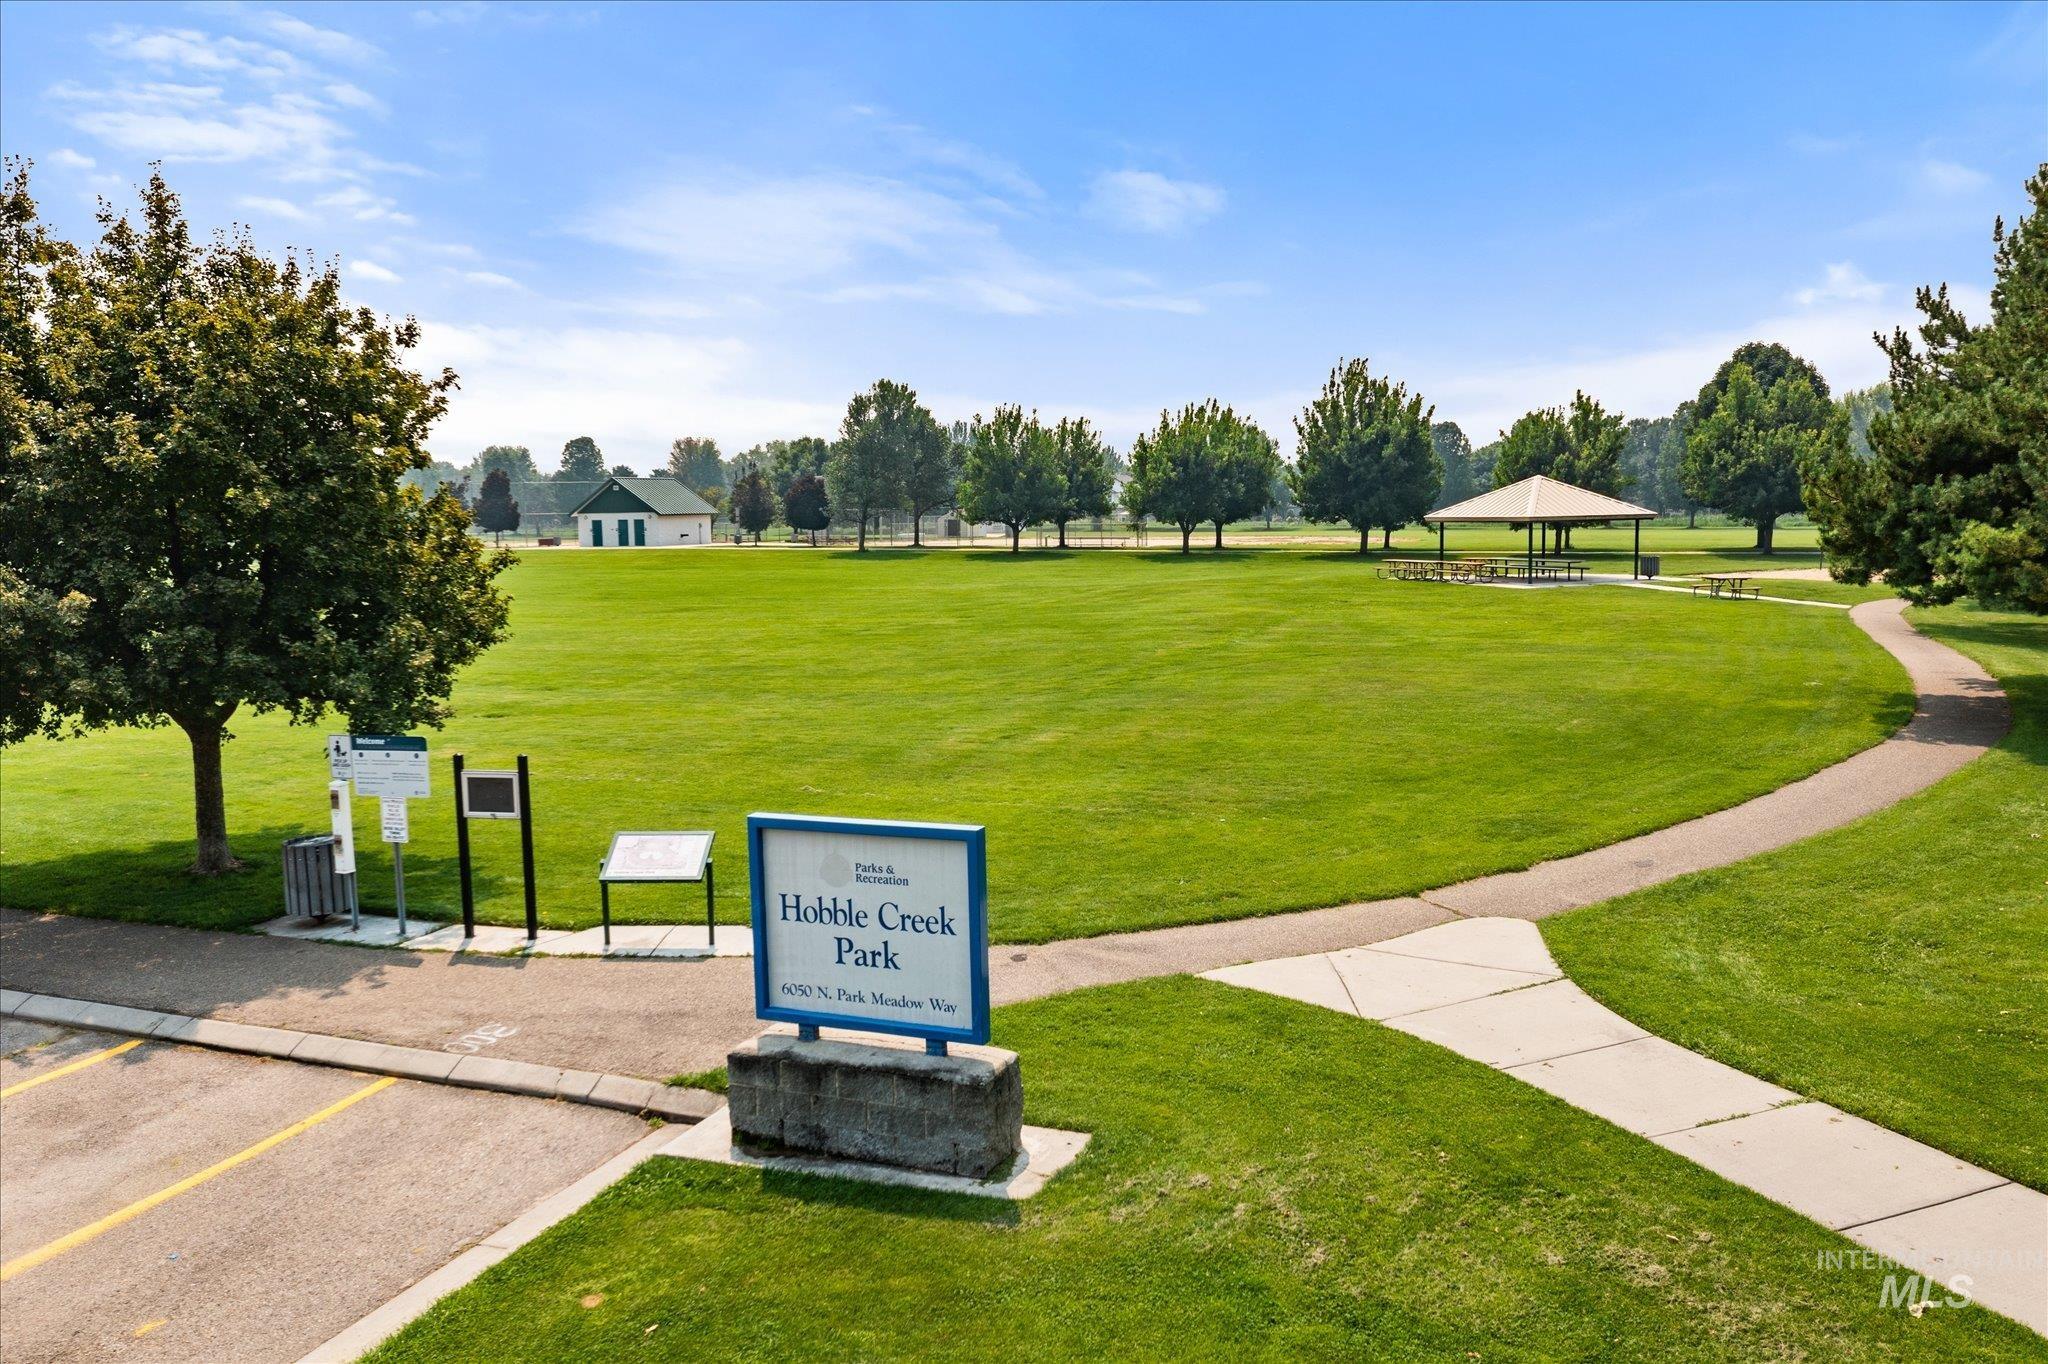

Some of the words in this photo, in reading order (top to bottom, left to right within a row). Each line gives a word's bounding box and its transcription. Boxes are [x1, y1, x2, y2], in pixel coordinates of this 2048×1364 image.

[356, 737, 385, 745] Welcome
[855, 862, 883, 873] Parks
[885, 865, 895, 874] &
[855, 874, 908, 886] Recreation
[779, 893, 868, 928] Hobble
[878, 902, 956, 936] Creek
[834, 937, 901, 970] Park
[782, 983, 812, 997] 6050
[817, 986, 832, 999] N.
[837, 988, 865, 1003] Park
[871, 992, 924, 1009] Meadow
[929, 998, 957, 1015] Way
